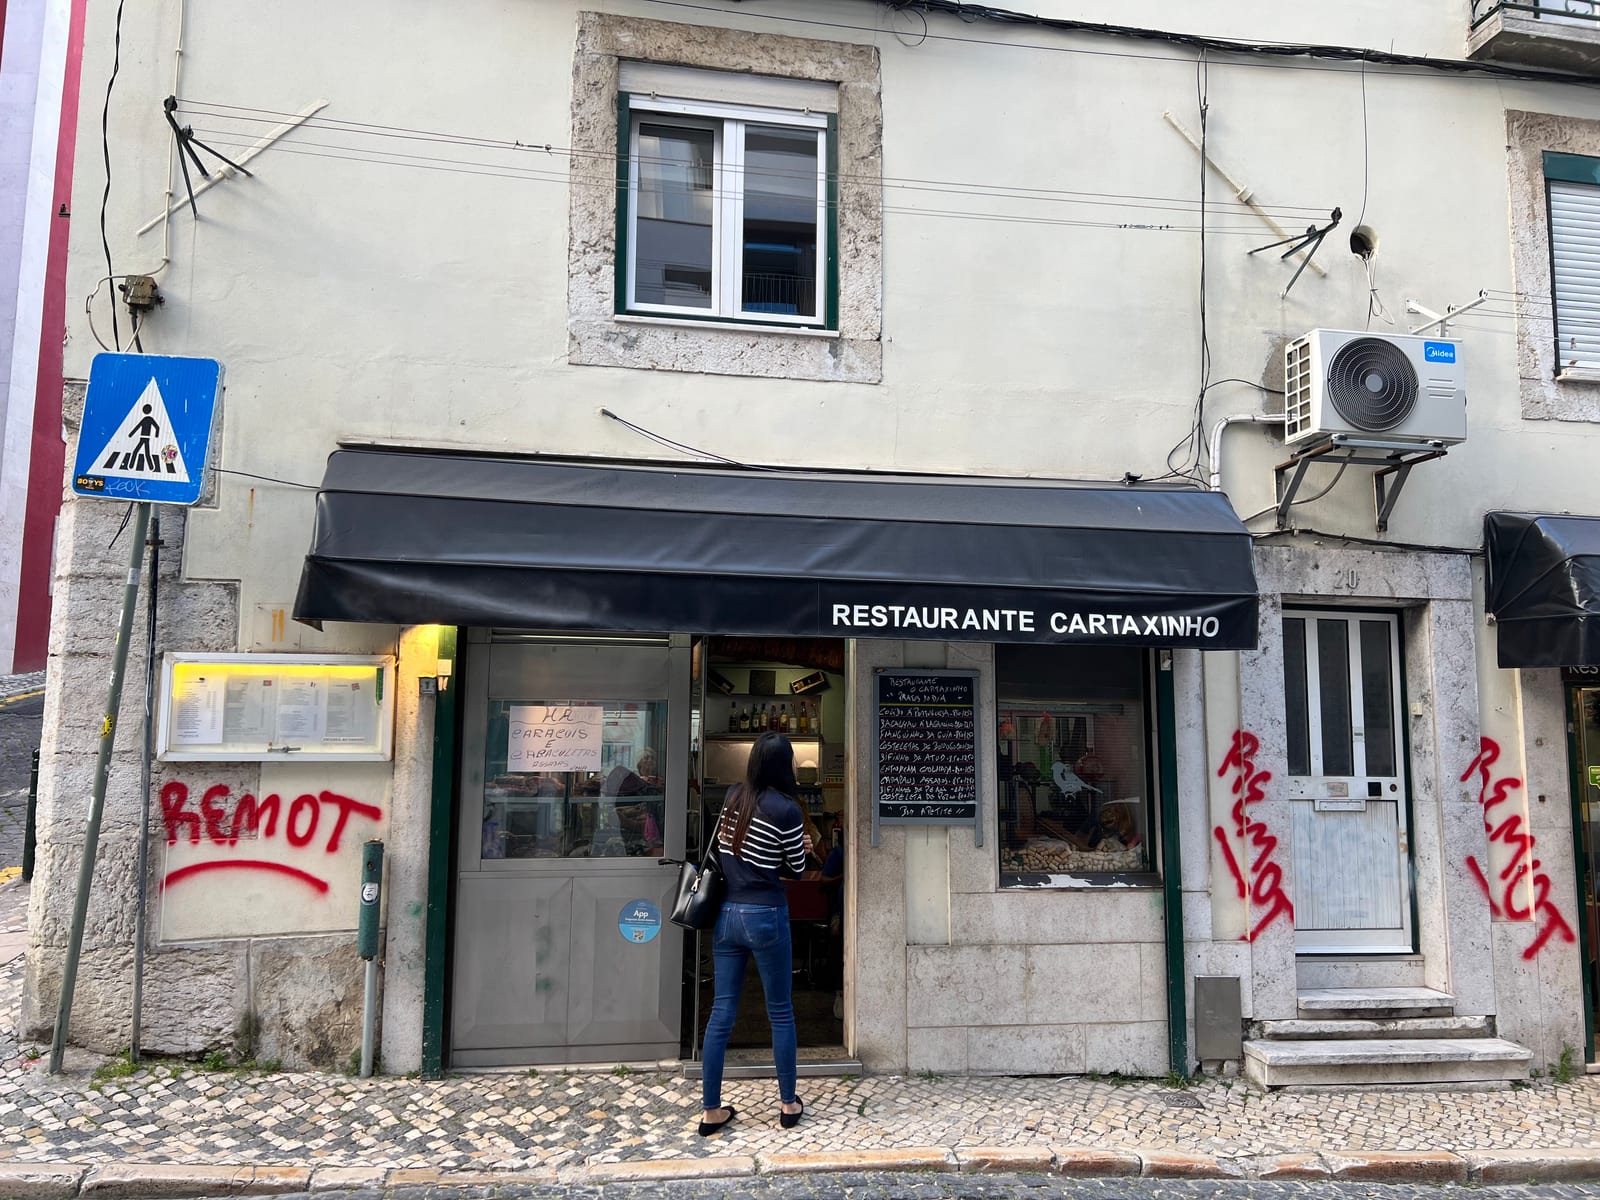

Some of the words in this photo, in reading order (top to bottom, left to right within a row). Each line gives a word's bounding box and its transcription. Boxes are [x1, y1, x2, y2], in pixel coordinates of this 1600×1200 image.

[1429, 349, 1454, 358] Midea
[1334, 568, 1357, 589] 20
[832, 604, 1035, 632] RESTAURANTE
[1050, 612, 1220, 638] CARTAXINHO
[159, 780, 384, 853] REMOT
[633, 909, 649, 918] App
